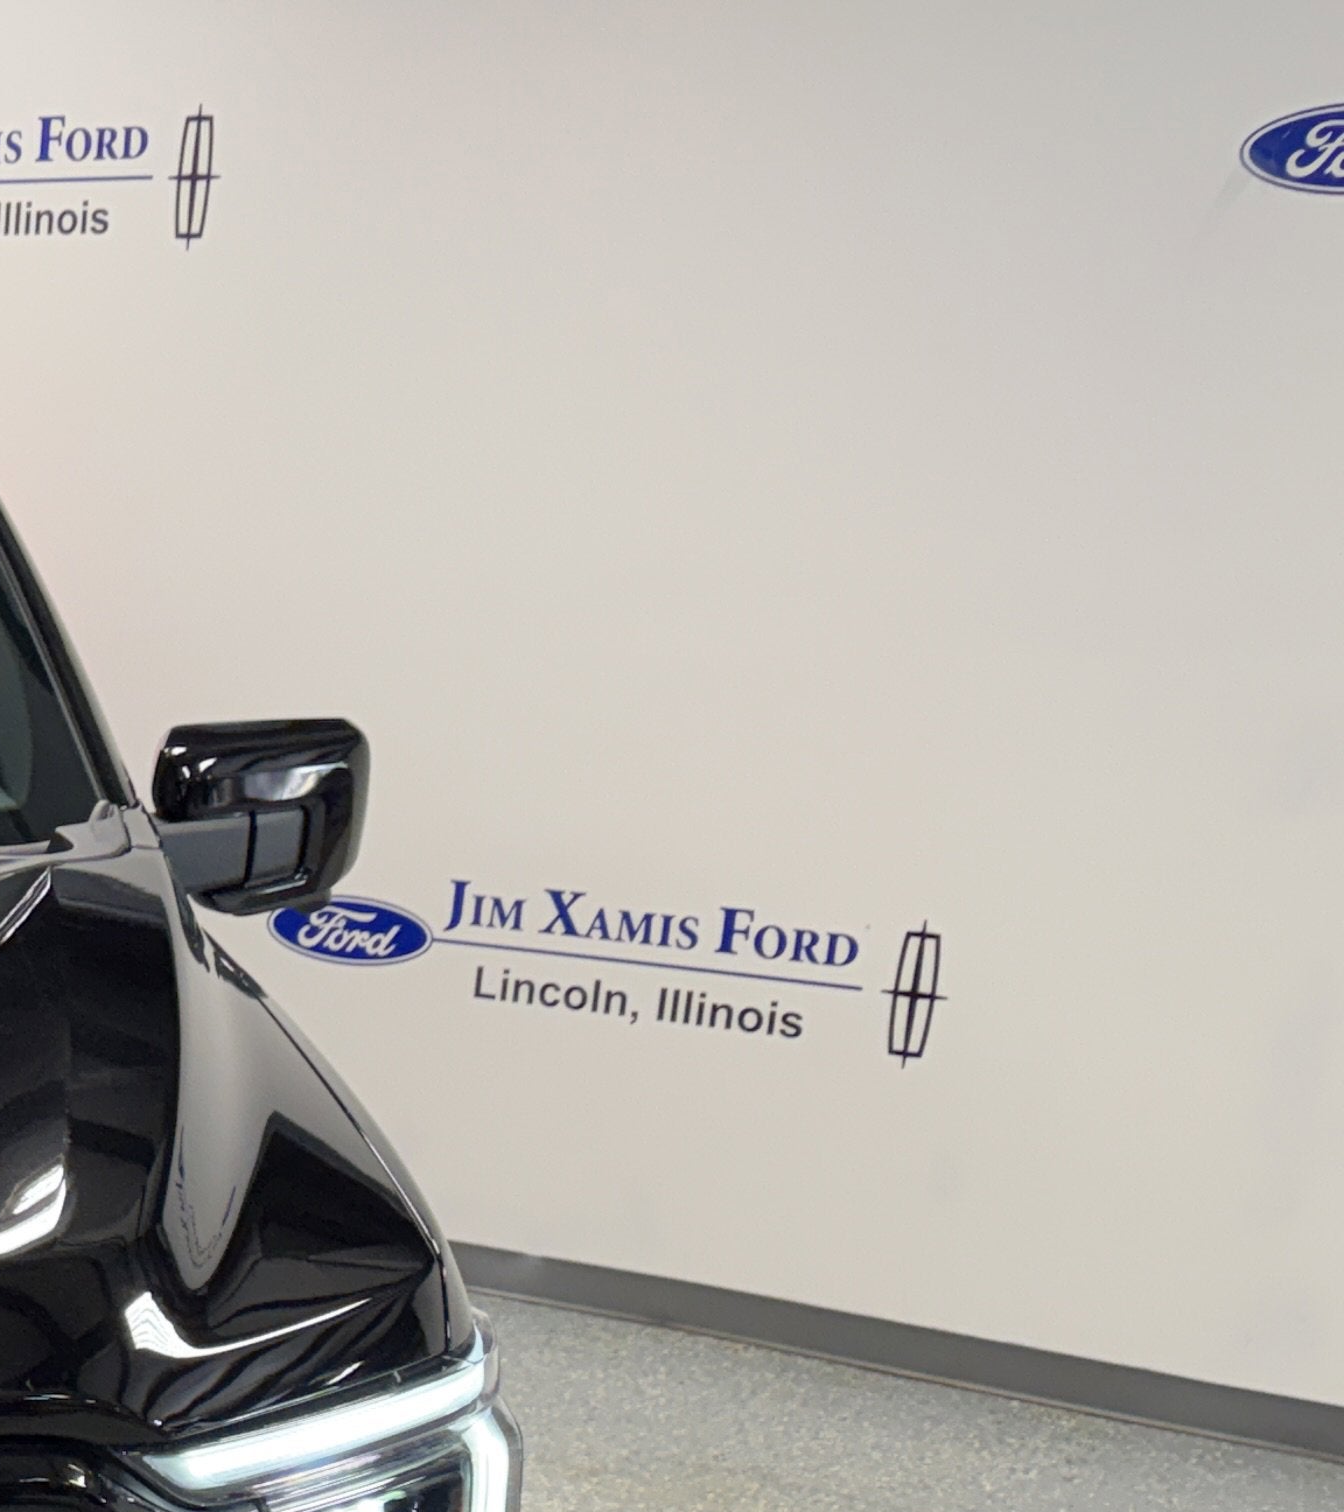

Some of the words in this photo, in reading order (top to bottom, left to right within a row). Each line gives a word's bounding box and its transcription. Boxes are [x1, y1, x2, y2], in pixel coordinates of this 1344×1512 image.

[35, 115, 149, 163] FORD
[297, 905, 401, 957] Ford
[442, 879, 526, 932] JIM
[537, 888, 699, 951] XAMIS
[714, 906, 859, 968] FORD
[473, 965, 640, 1025] Lincoln,
[656, 987, 803, 1039] Illinois
